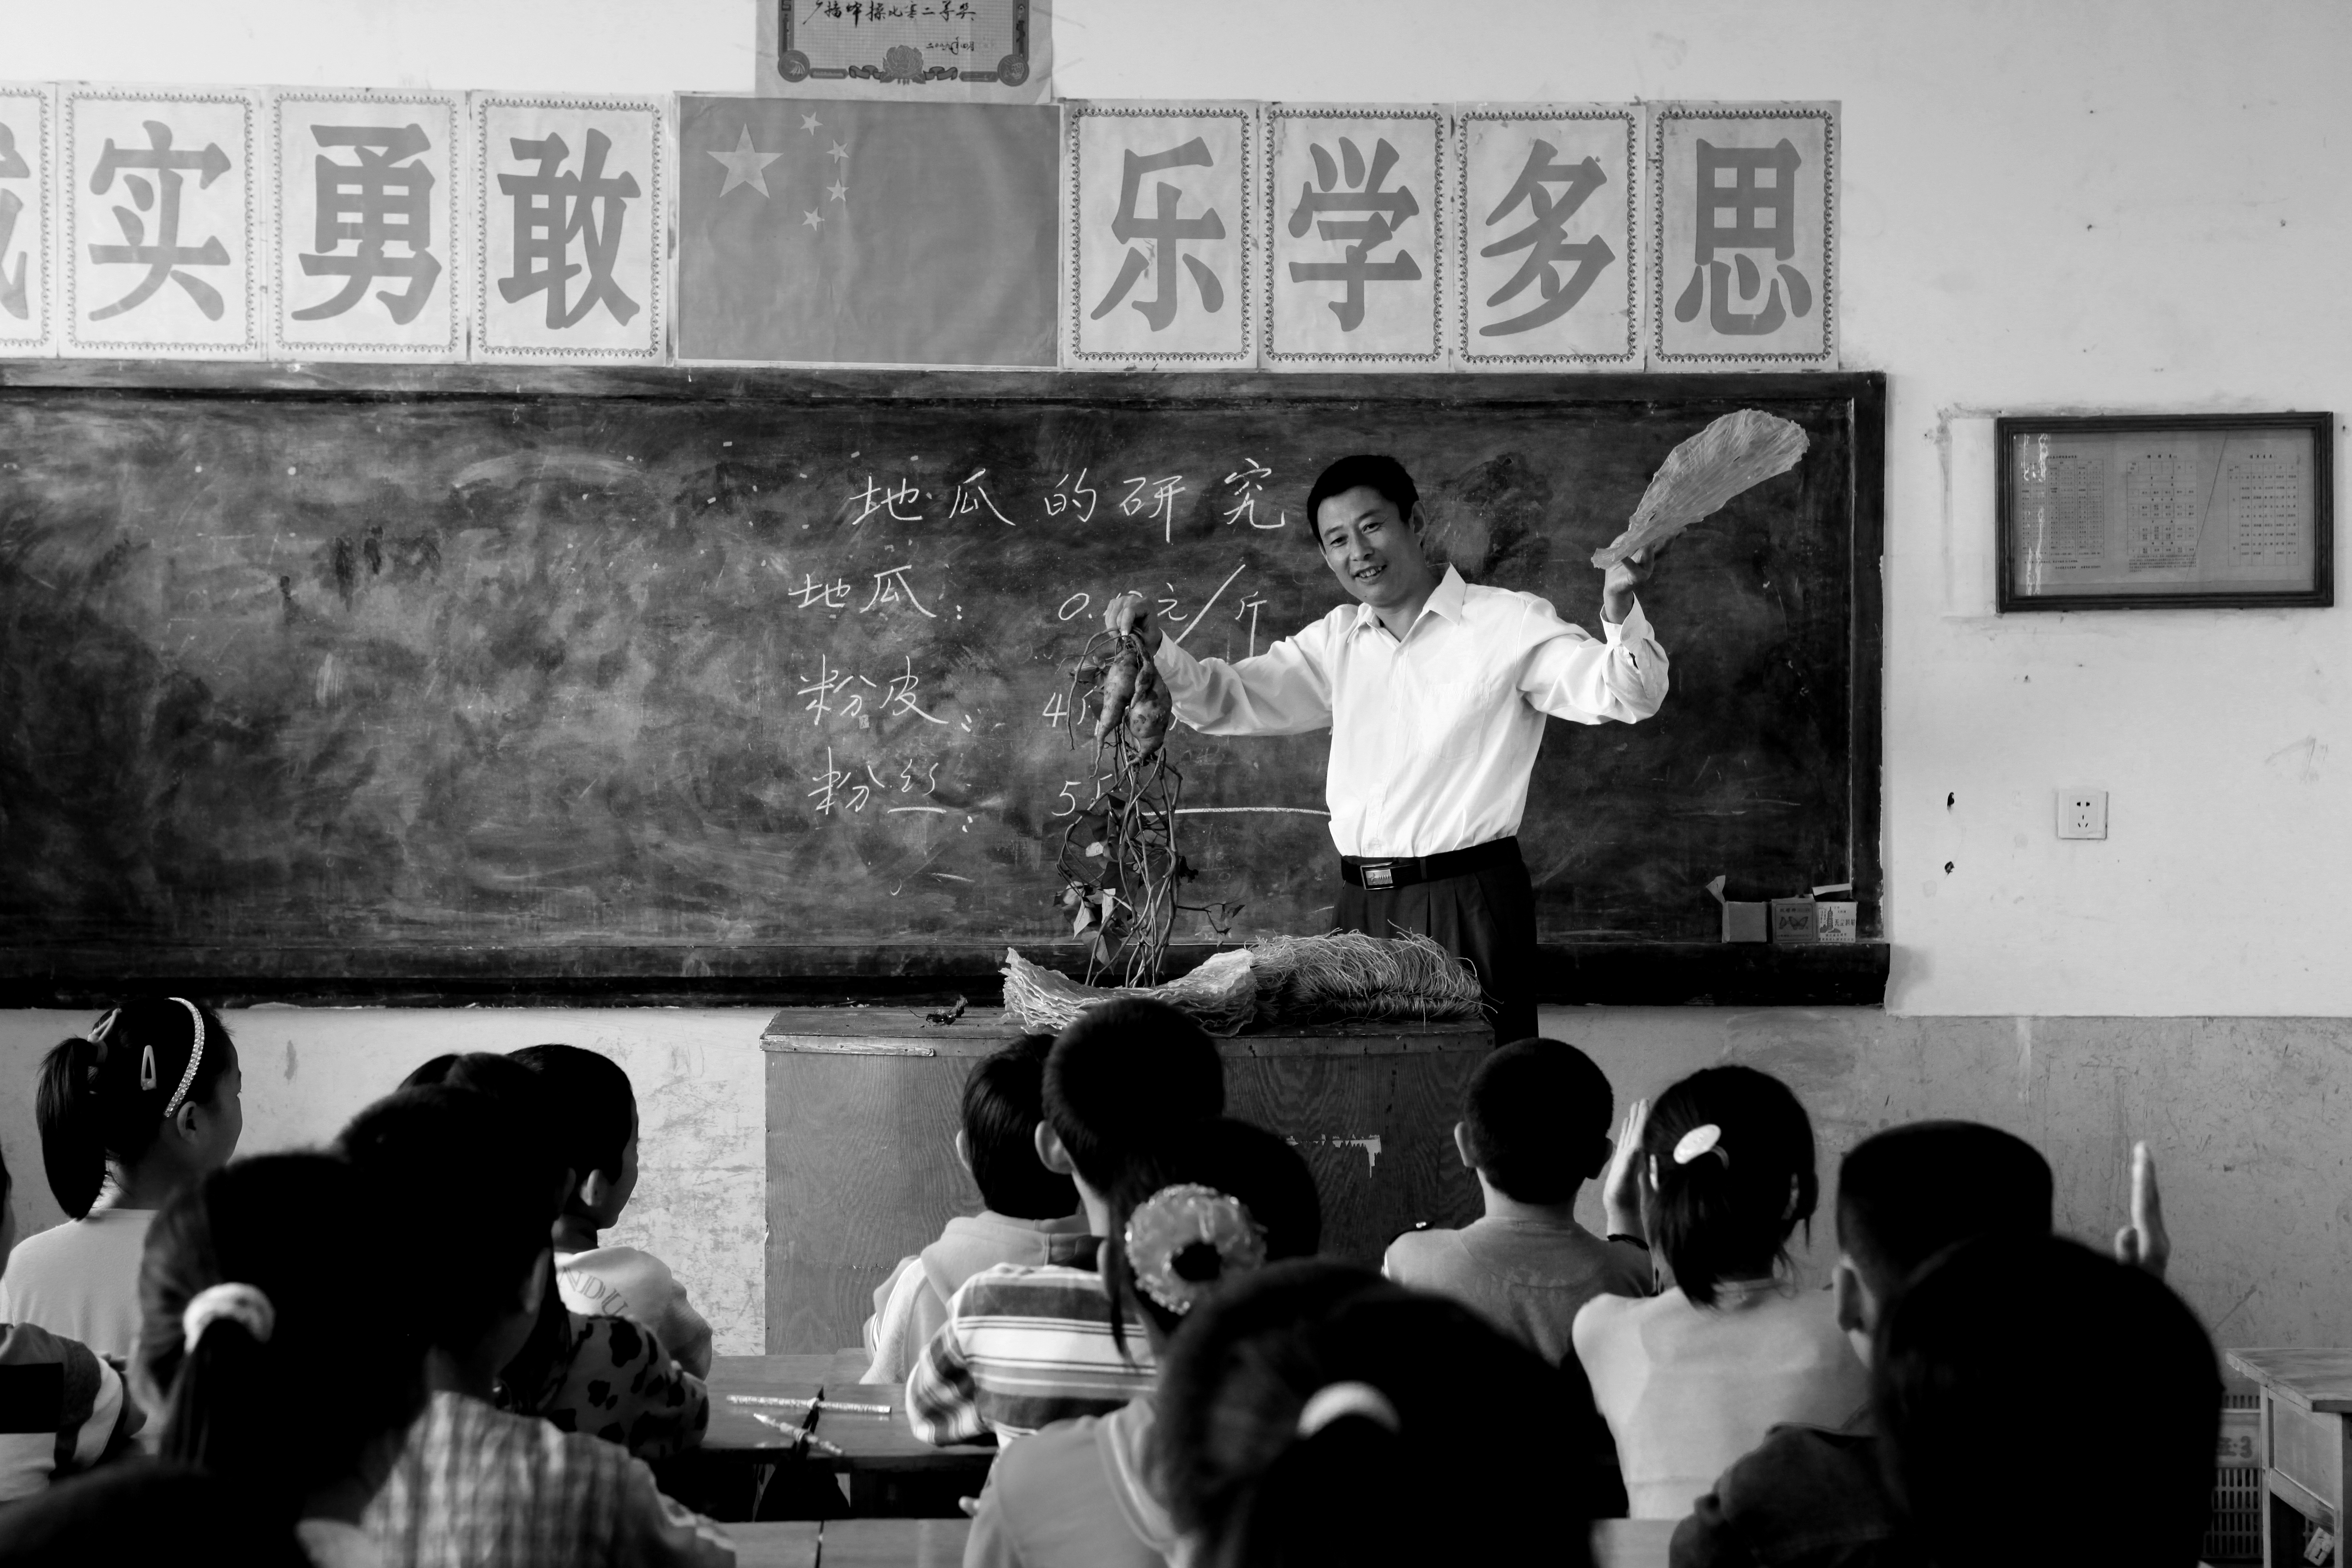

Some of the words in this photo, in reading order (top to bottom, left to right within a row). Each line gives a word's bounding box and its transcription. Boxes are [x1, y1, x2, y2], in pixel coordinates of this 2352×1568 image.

[1090, 136, 1812, 336] 乐学多思
[849, 458, 1285, 543] 地瓜的研究
